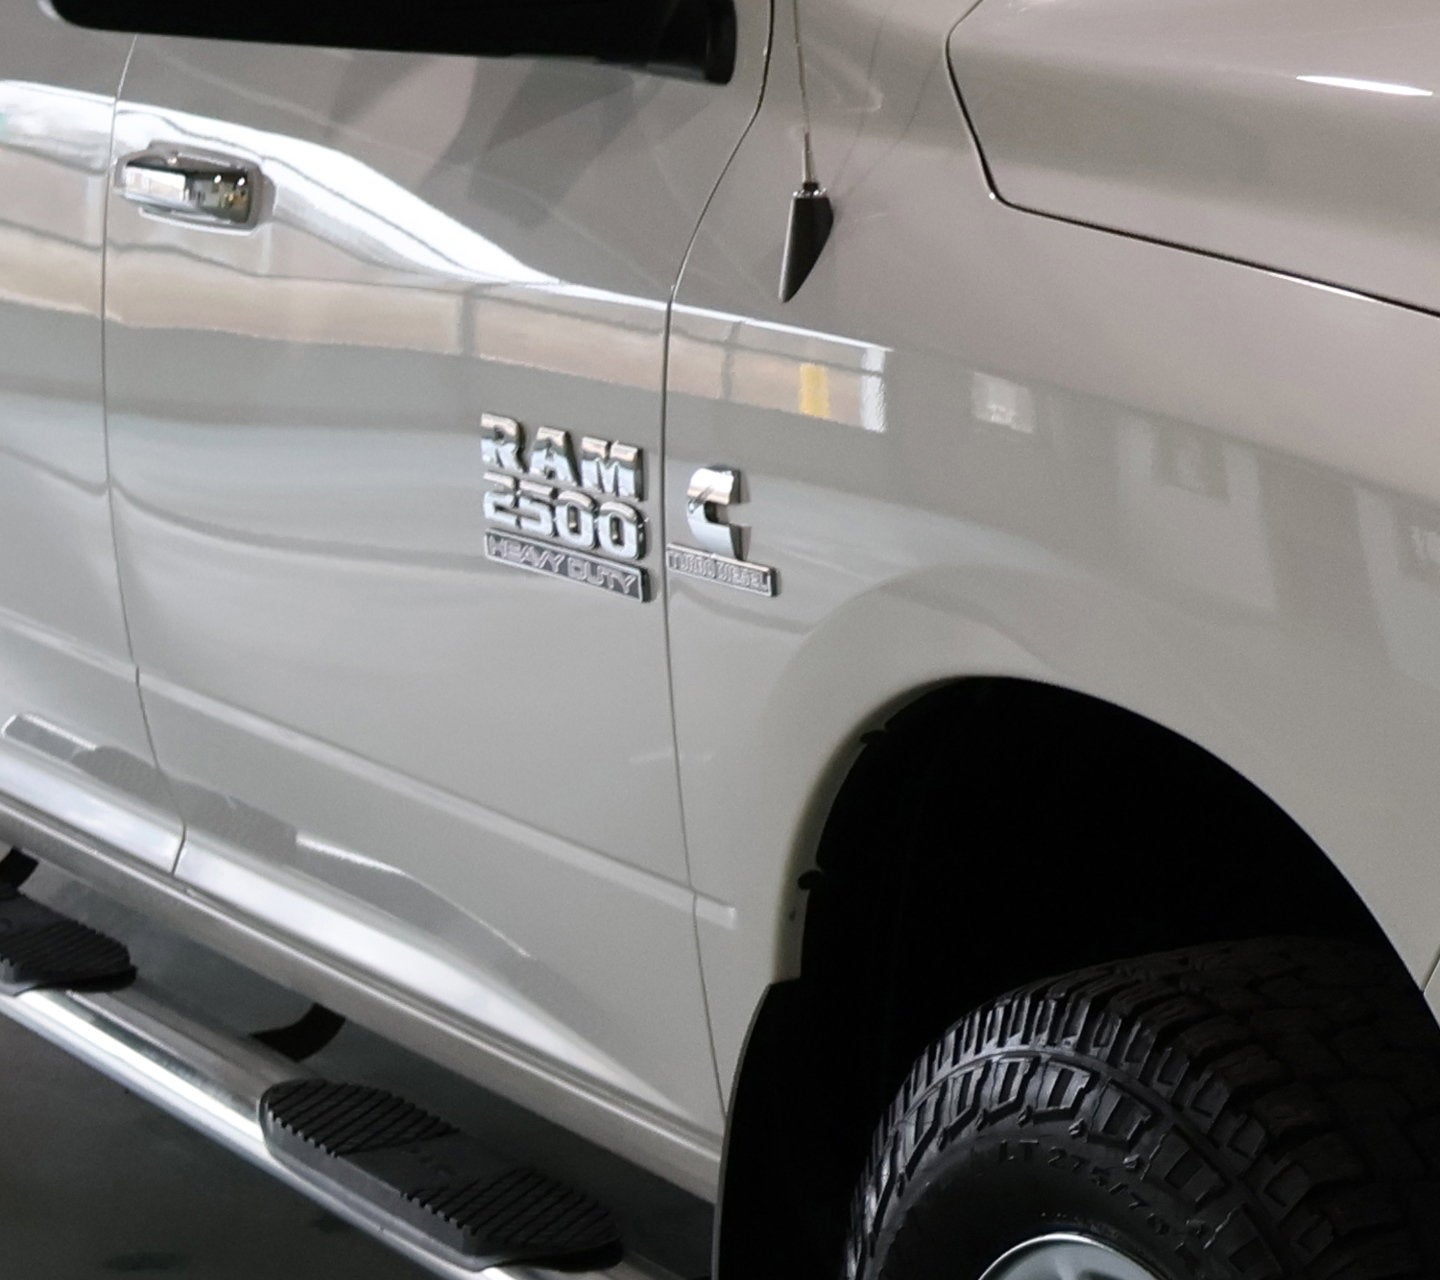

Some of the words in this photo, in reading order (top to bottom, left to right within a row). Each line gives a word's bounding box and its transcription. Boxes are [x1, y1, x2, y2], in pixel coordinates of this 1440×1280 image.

[480, 412, 643, 502] RAM
[483, 471, 646, 560] 2500
[487, 536, 565, 577] HEAVY
[567, 557, 637, 594] DUTY
